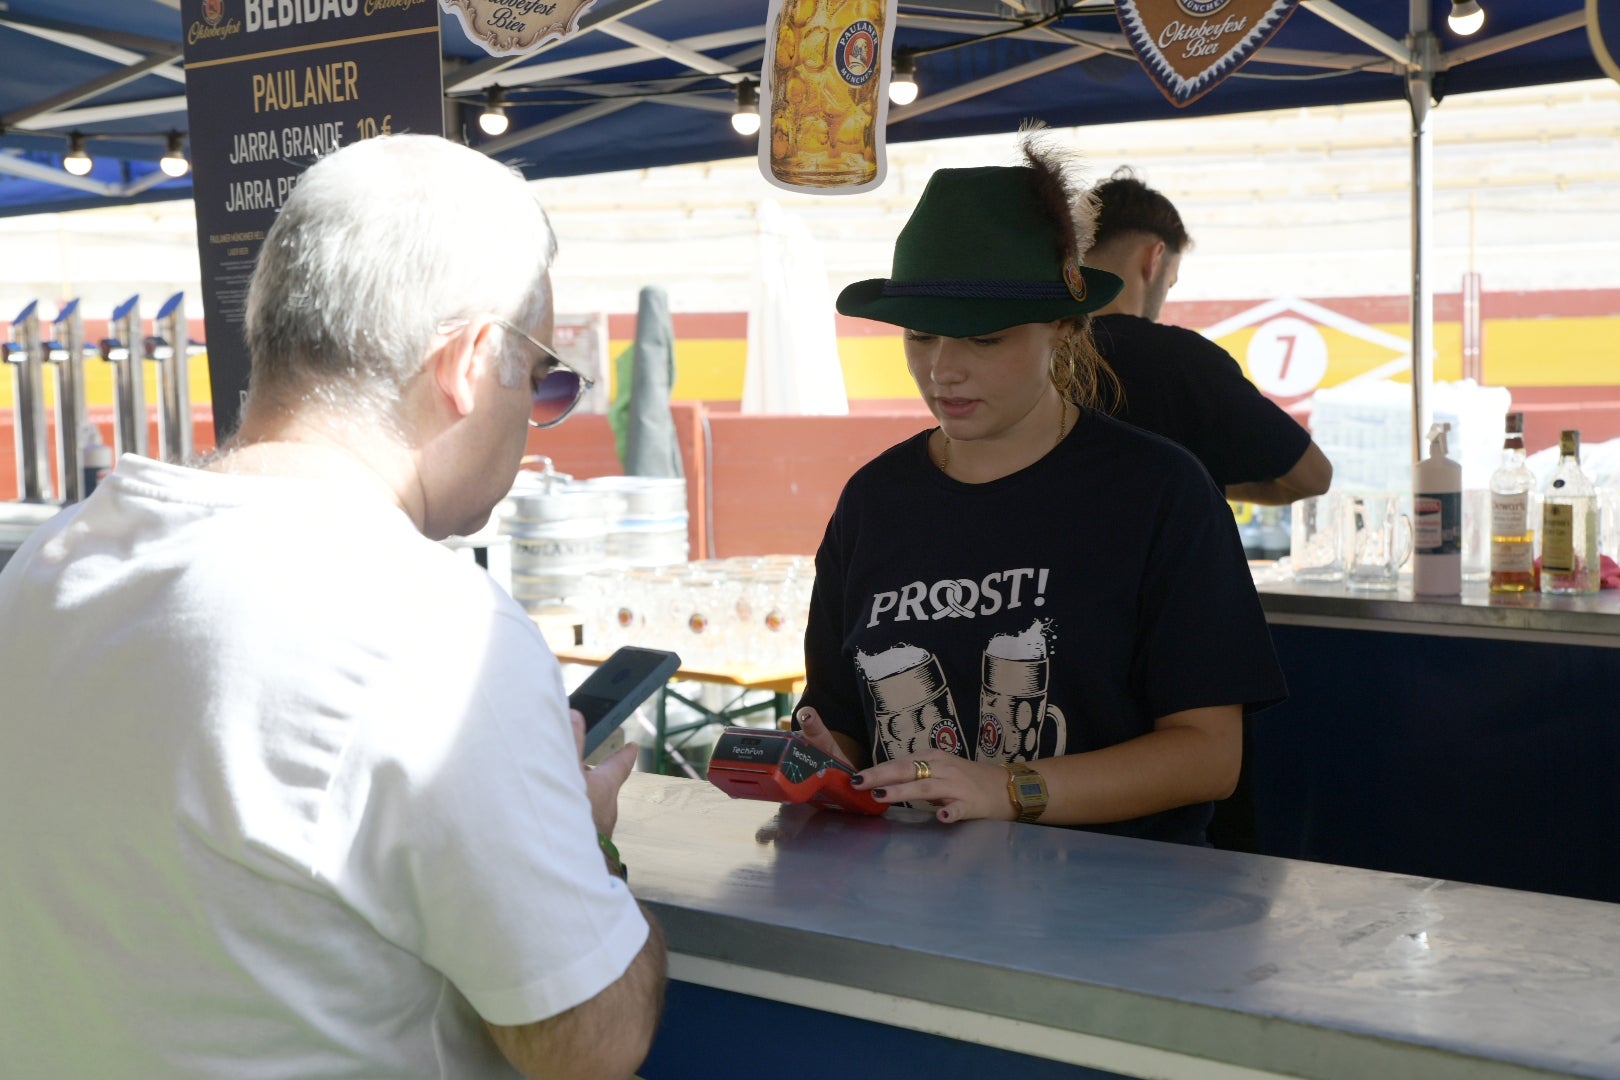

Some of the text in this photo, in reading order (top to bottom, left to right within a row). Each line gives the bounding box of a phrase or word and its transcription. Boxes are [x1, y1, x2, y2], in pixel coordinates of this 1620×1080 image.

[486, 7, 526, 33] Bier
[487, 0, 557, 15] oberfest
[187, 18, 241, 45] Oktoberfest
[840, 22, 878, 46] PAULANER
[1158, 14, 1248, 49] Oktoberfest
[1182, 37, 1219, 59] Bier
[252, 60, 359, 114] PAULANER
[229, 131, 280, 164] JARRA
[282, 121, 344, 158] GRANDE
[380, 114, 392, 136] €
[225, 175, 302, 213] JARRA PE
[1276, 335, 1297, 381] 7
[732, 746, 764, 756] TechFun
[792, 746, 818, 769] TechFun
